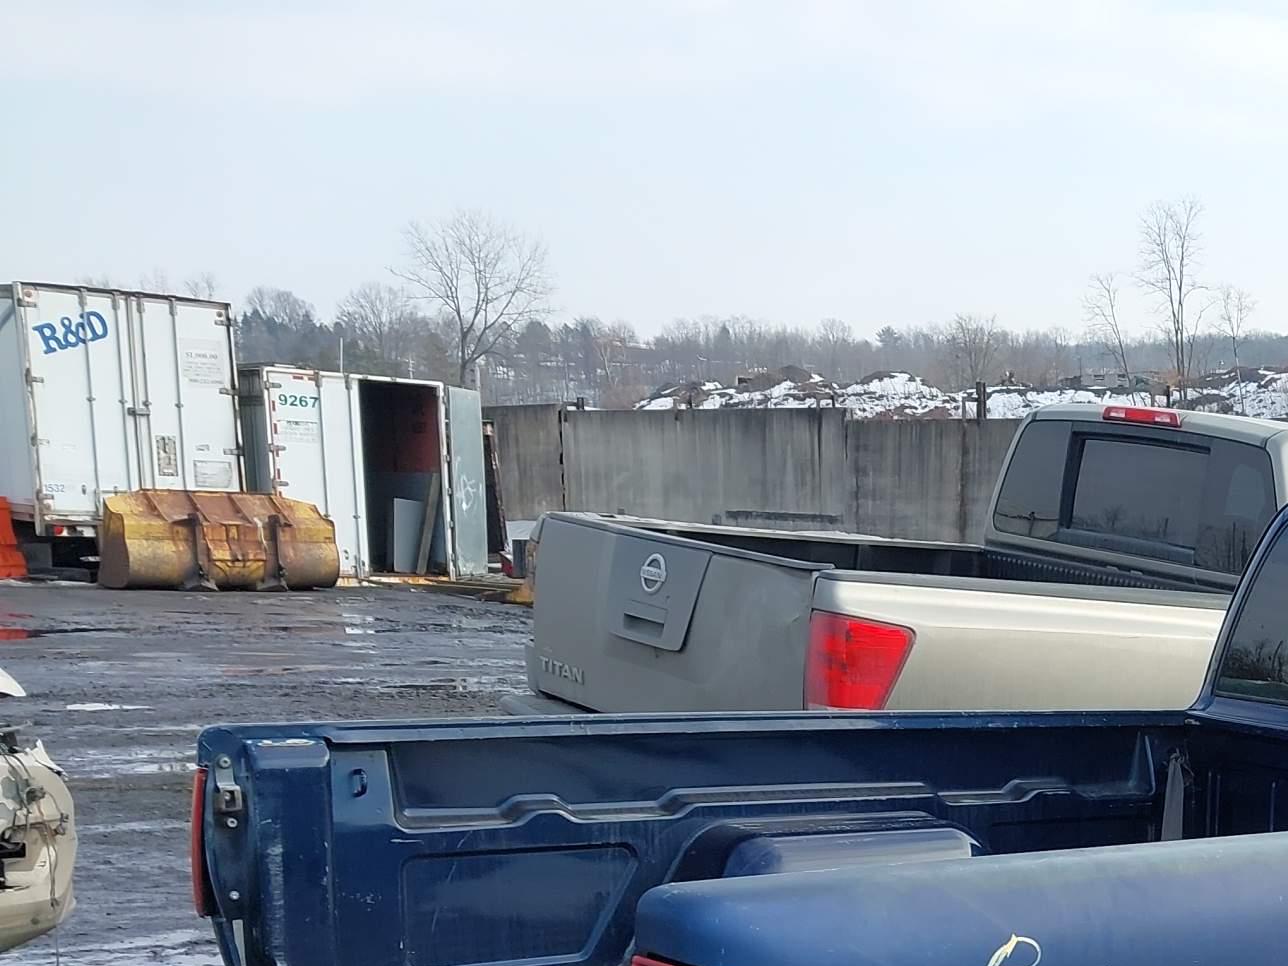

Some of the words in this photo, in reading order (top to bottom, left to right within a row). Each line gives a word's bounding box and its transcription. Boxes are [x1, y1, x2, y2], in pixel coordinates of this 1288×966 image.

[32, 310, 108, 355] R&D
[278, 394, 320, 408] 9267
[45, 483, 65, 493] 1532
[540, 656, 585, 685] TITAN
